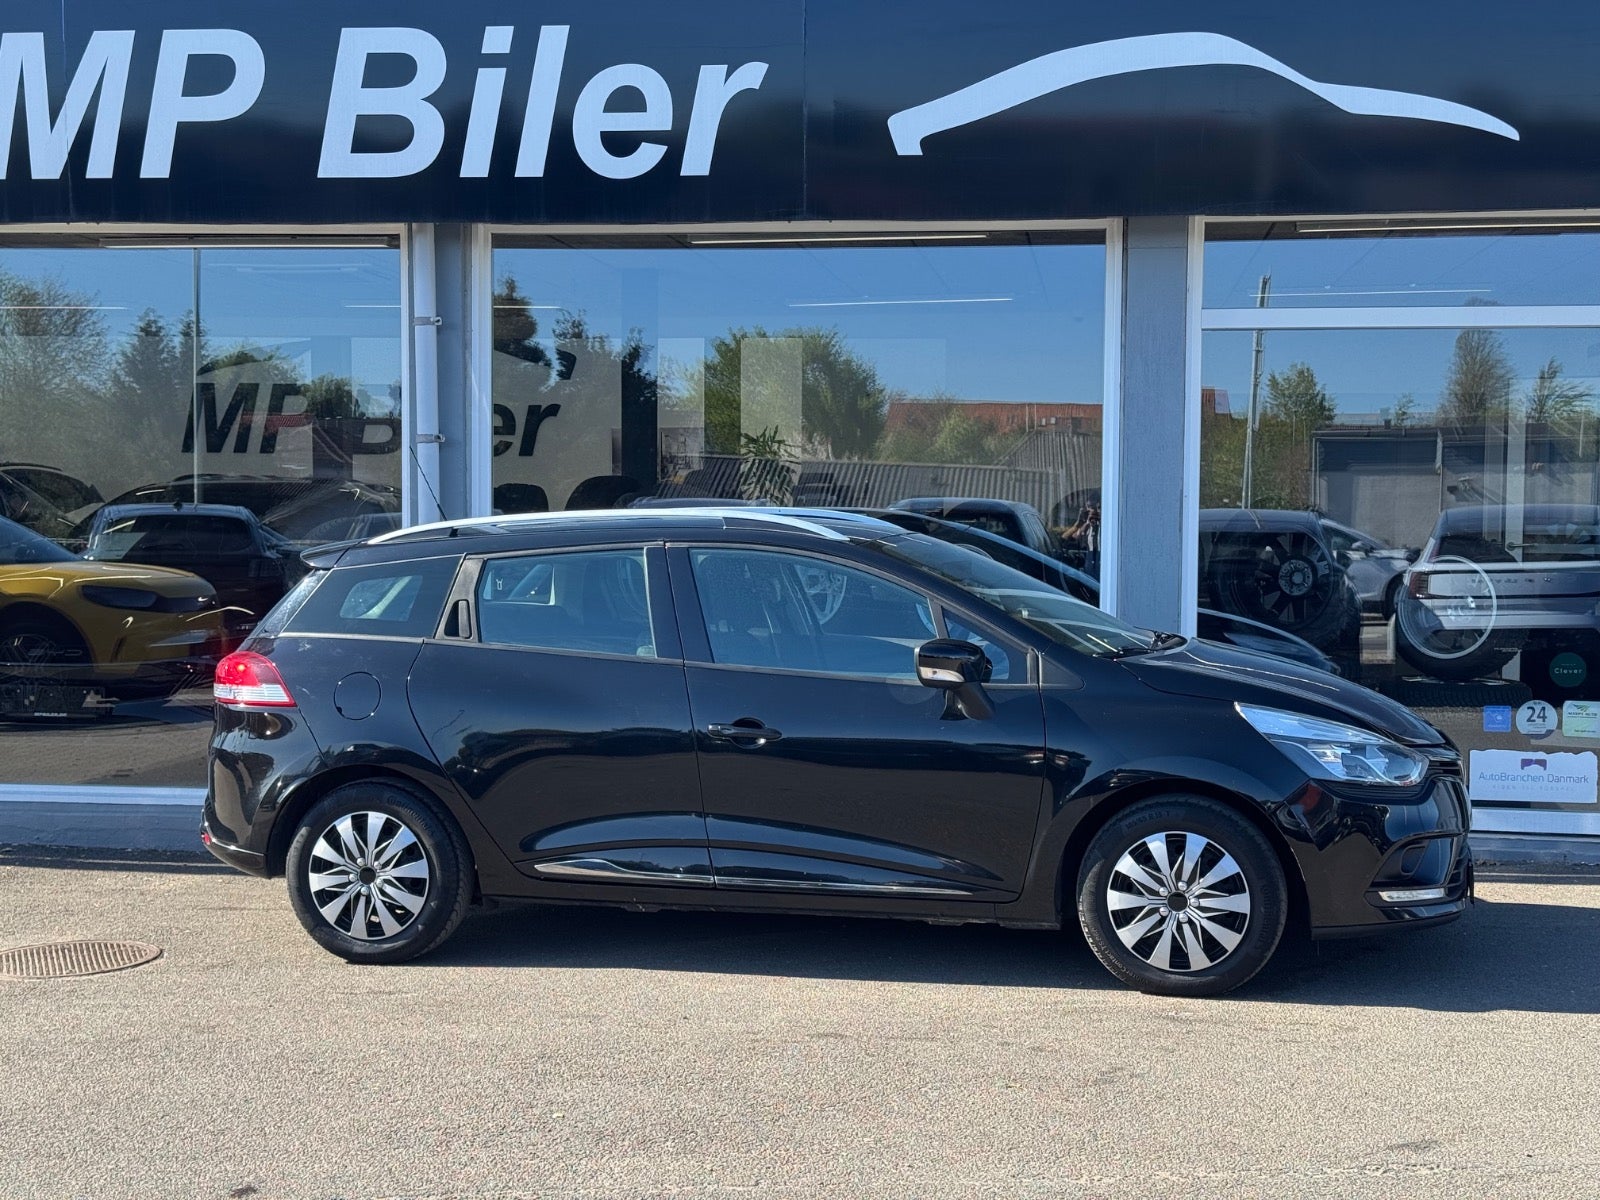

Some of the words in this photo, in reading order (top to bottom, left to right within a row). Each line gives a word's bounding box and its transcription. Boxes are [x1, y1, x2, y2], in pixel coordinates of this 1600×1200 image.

[0, 28, 266, 180] MP
[317, 24, 769, 180] Biler
[181, 382, 315, 455] MP
[1553, 666, 1584, 675] Clever
[1526, 706, 1548, 723] 24
[1478, 771, 1545, 783] AutoBranchen
[1547, 773, 1589, 784] Danmark
